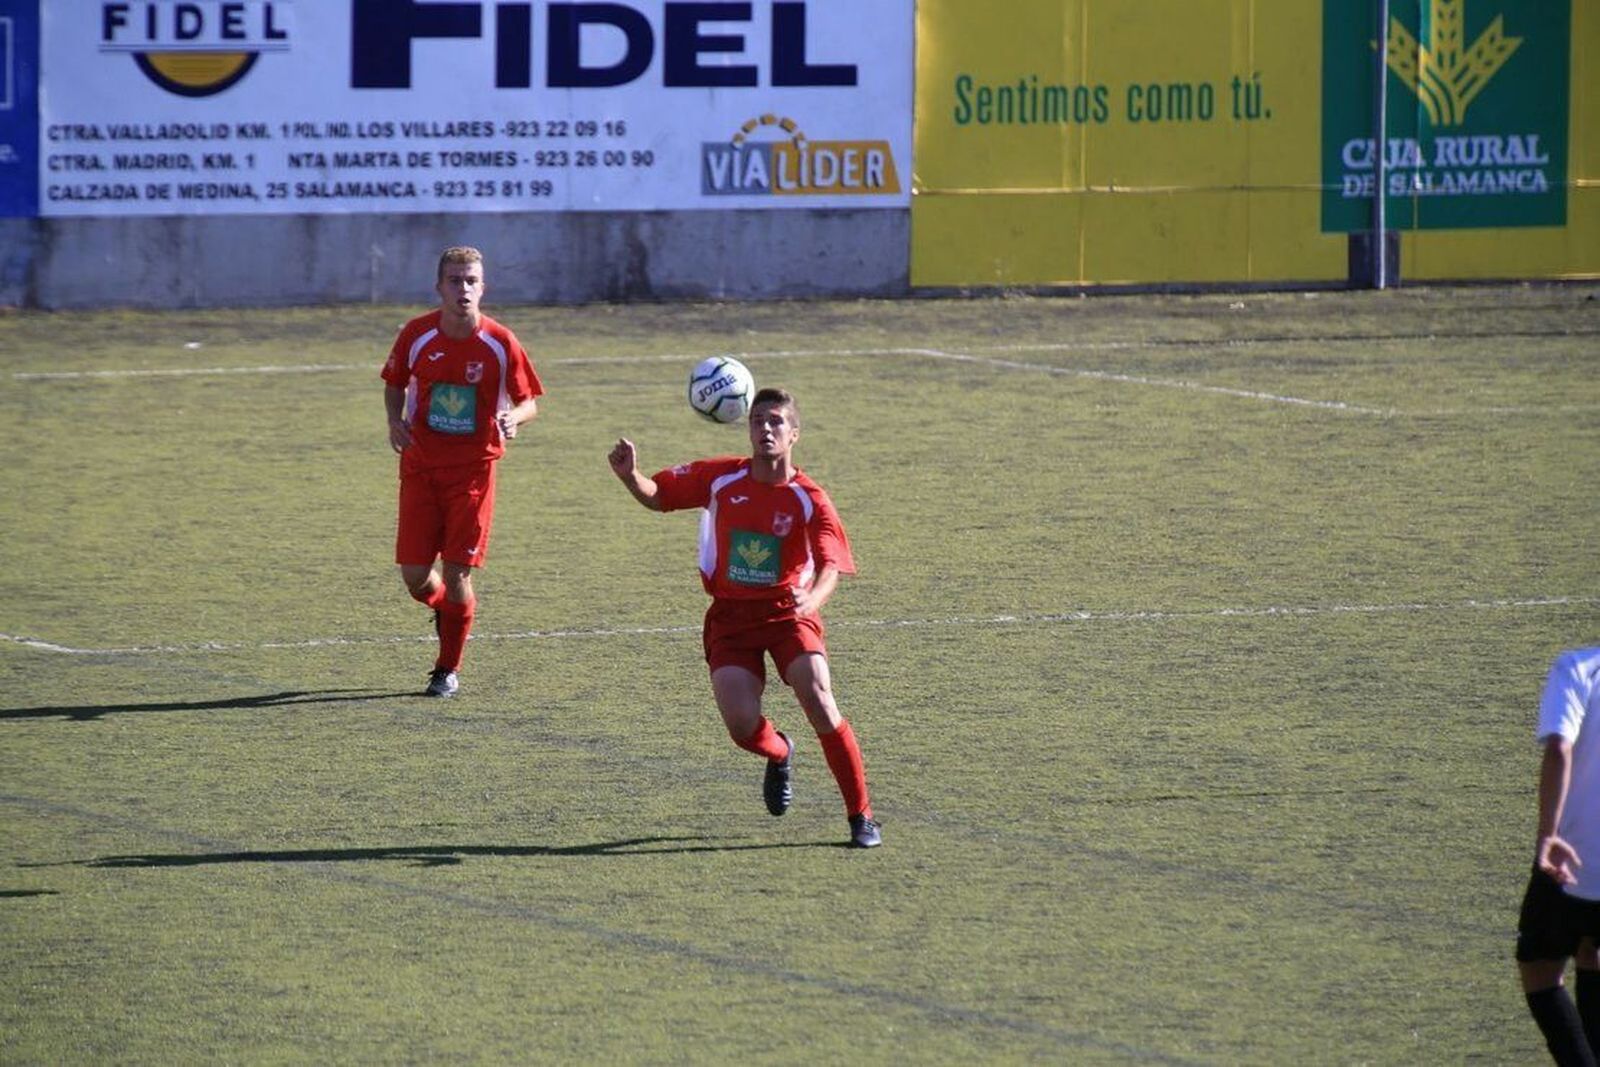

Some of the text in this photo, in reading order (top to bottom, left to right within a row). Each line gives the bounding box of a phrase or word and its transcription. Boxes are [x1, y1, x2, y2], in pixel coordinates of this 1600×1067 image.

[102, 2, 288, 40] FIDEL
[350, 0, 858, 88] FIDEL
[954, 72, 1271, 125] Sentimos como tú.
[357, 121, 394, 138] LOS
[401, 121, 494, 138] VILLARES
[546, 120, 569, 137] 22
[574, 120, 598, 137] 09
[604, 120, 627, 137] 16
[47, 154, 106, 171] CTRA.
[203, 152, 237, 169] KM.
[245, 153, 255, 169] 1
[333, 151, 401, 168] MARTA
[407, 151, 432, 168] DE
[439, 151, 518, 167] TORMES
[534, 150, 569, 167] 923
[575, 150, 598, 167] 26
[603, 150, 626, 167] 00
[632, 150, 654, 167] 90
[1434, 134, 1549, 166] RURAL
[47, 183, 138, 201] CALZADA
[145, 183, 170, 200] DE
[266, 181, 288, 199] 25
[294, 181, 416, 198] SALAMANCA
[433, 180, 468, 197] 923
[473, 180, 496, 197] 25
[501, 180, 523, 196] 81
[529, 180, 553, 196] 99
[1389, 169, 1548, 196] SALAMANCA
